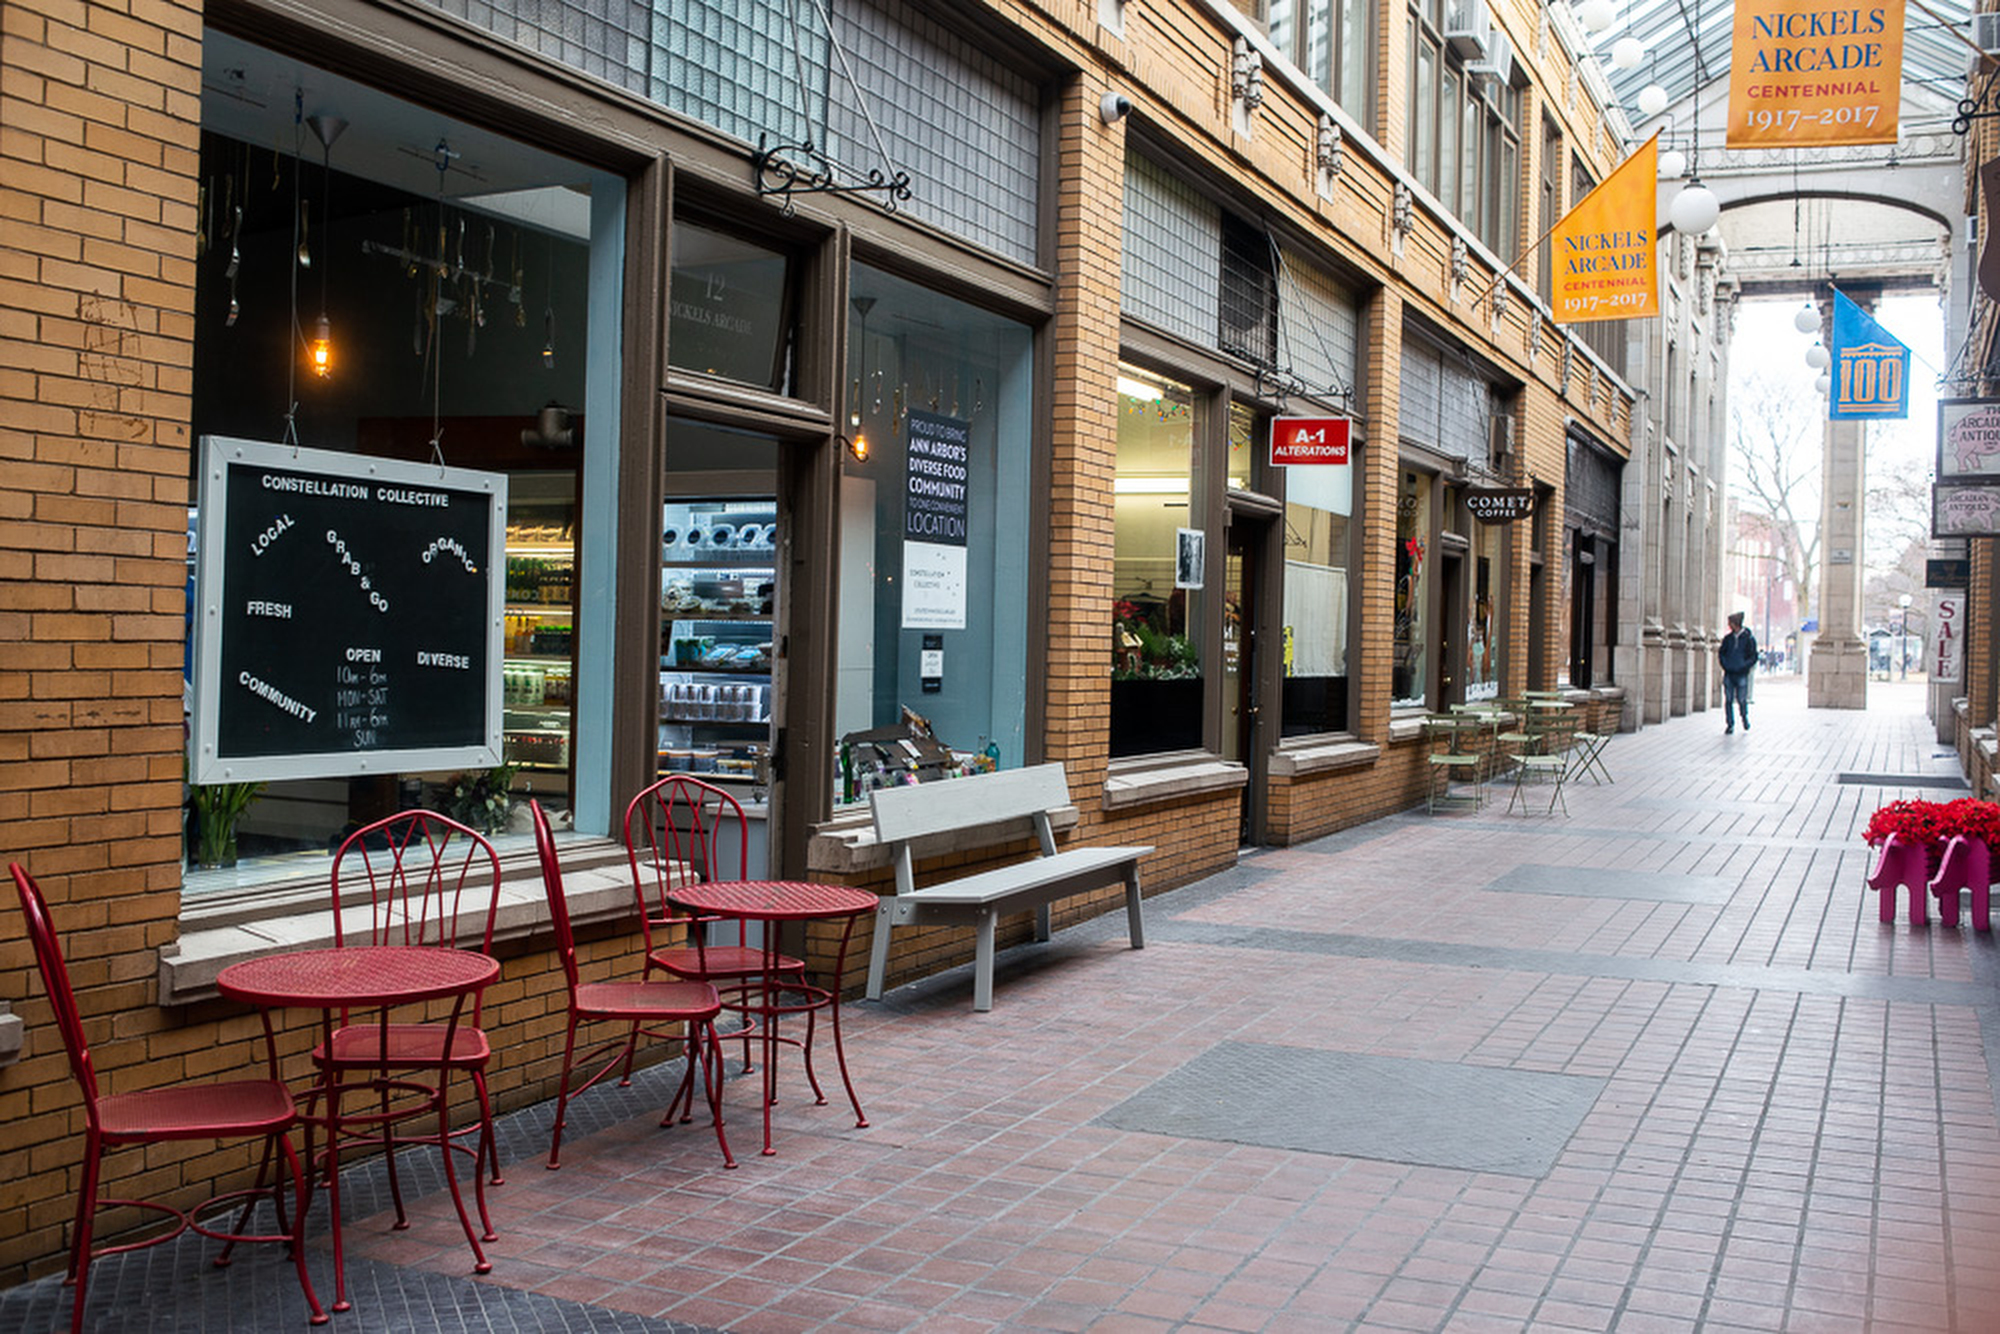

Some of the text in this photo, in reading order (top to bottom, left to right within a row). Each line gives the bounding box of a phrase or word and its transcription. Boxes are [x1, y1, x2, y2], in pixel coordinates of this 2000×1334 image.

[1752, 8, 1885, 39] NICKELS
[1750, 43, 1883, 73] ARCADE
[1748, 80, 1880, 99] CENTENNIAL
[1565, 230, 1647, 253] NICKELS
[1565, 252, 1647, 275] ARCADE
[705, 272, 725, 301] 12
[1564, 277, 1647, 291] CENTENNIAL
[1839, 358, 1902, 402] 100
[910, 419, 966, 442] PROUD TO BRING
[1295, 428, 1325, 443] A-1
[910, 438, 966, 462] ANN ARBOR'S
[1274, 445, 1346, 456] ALTERATIONS
[909, 457, 966, 480] DIVERSE FOOD
[262, 475, 449, 507] CONSTELLATION COLLECTIVE
[909, 477, 965, 500] COMMUNITY
[1467, 496, 1528, 508] COMET
[1477, 509, 1516, 517] COFFEE
[251, 514, 295, 556] LOCAL
[907, 511, 965, 537] LOCATION
[422, 537, 474, 572] ORGANIC
[327, 530, 388, 612] GRAB & GO
[247, 601, 292, 618] FRESH
[1937, 601, 1955, 677] SALE
[346, 648, 381, 662] OPEN
[417, 652, 469, 669] DIVERSE
[239, 671, 317, 724] COMMUNITY
[353, 729, 377, 747] SUN
